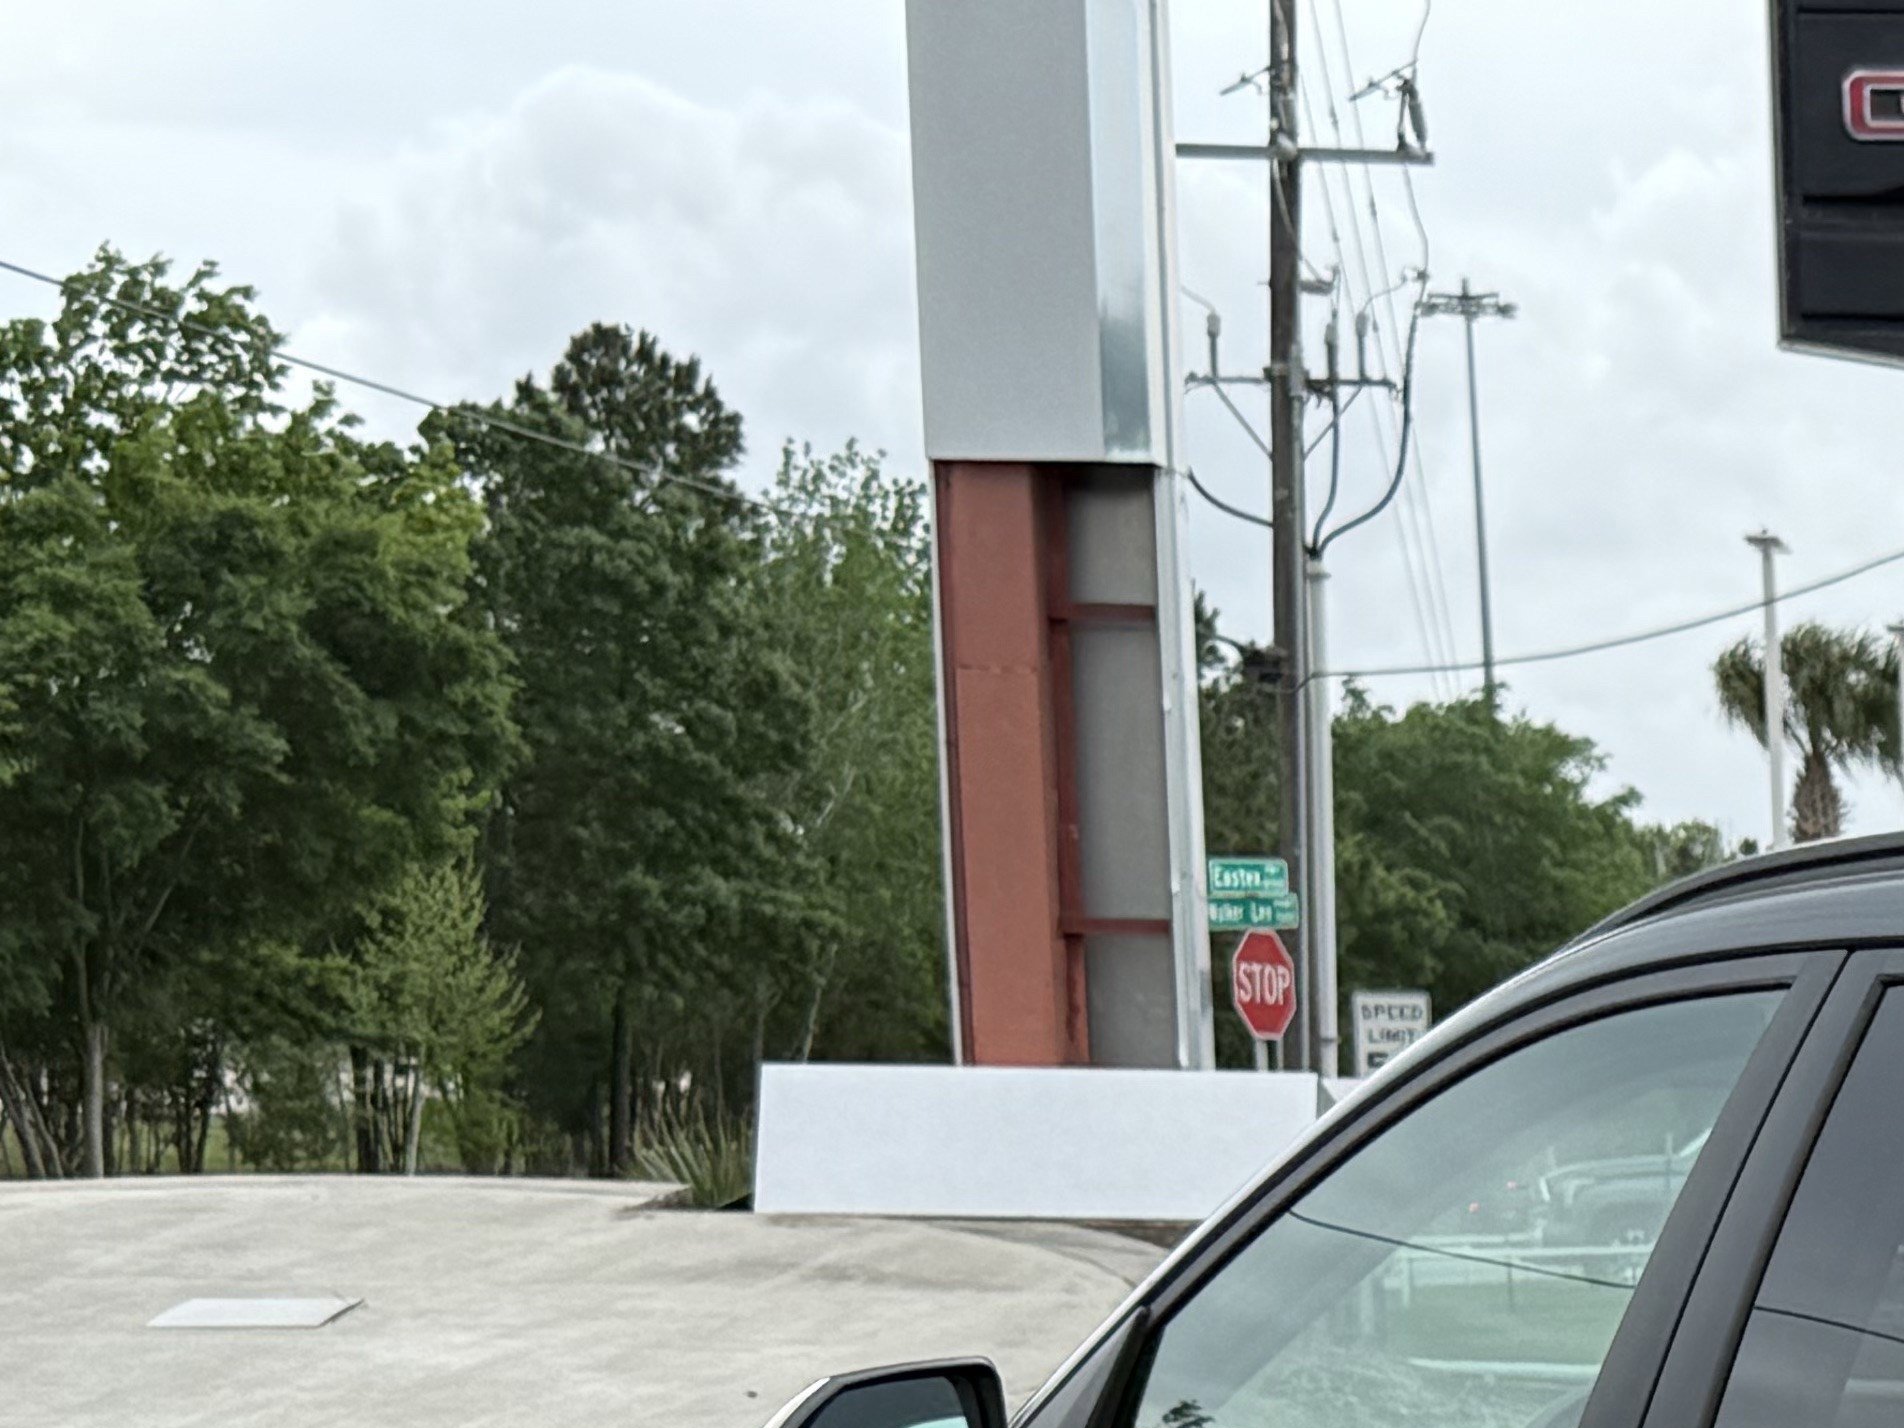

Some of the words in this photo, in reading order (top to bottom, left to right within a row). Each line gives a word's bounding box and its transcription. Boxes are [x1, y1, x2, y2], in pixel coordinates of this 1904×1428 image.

[1238, 960, 1291, 1006] STOP
[1361, 1003, 1423, 1021] SPEED
[1367, 1027, 1418, 1045] LIMIT
